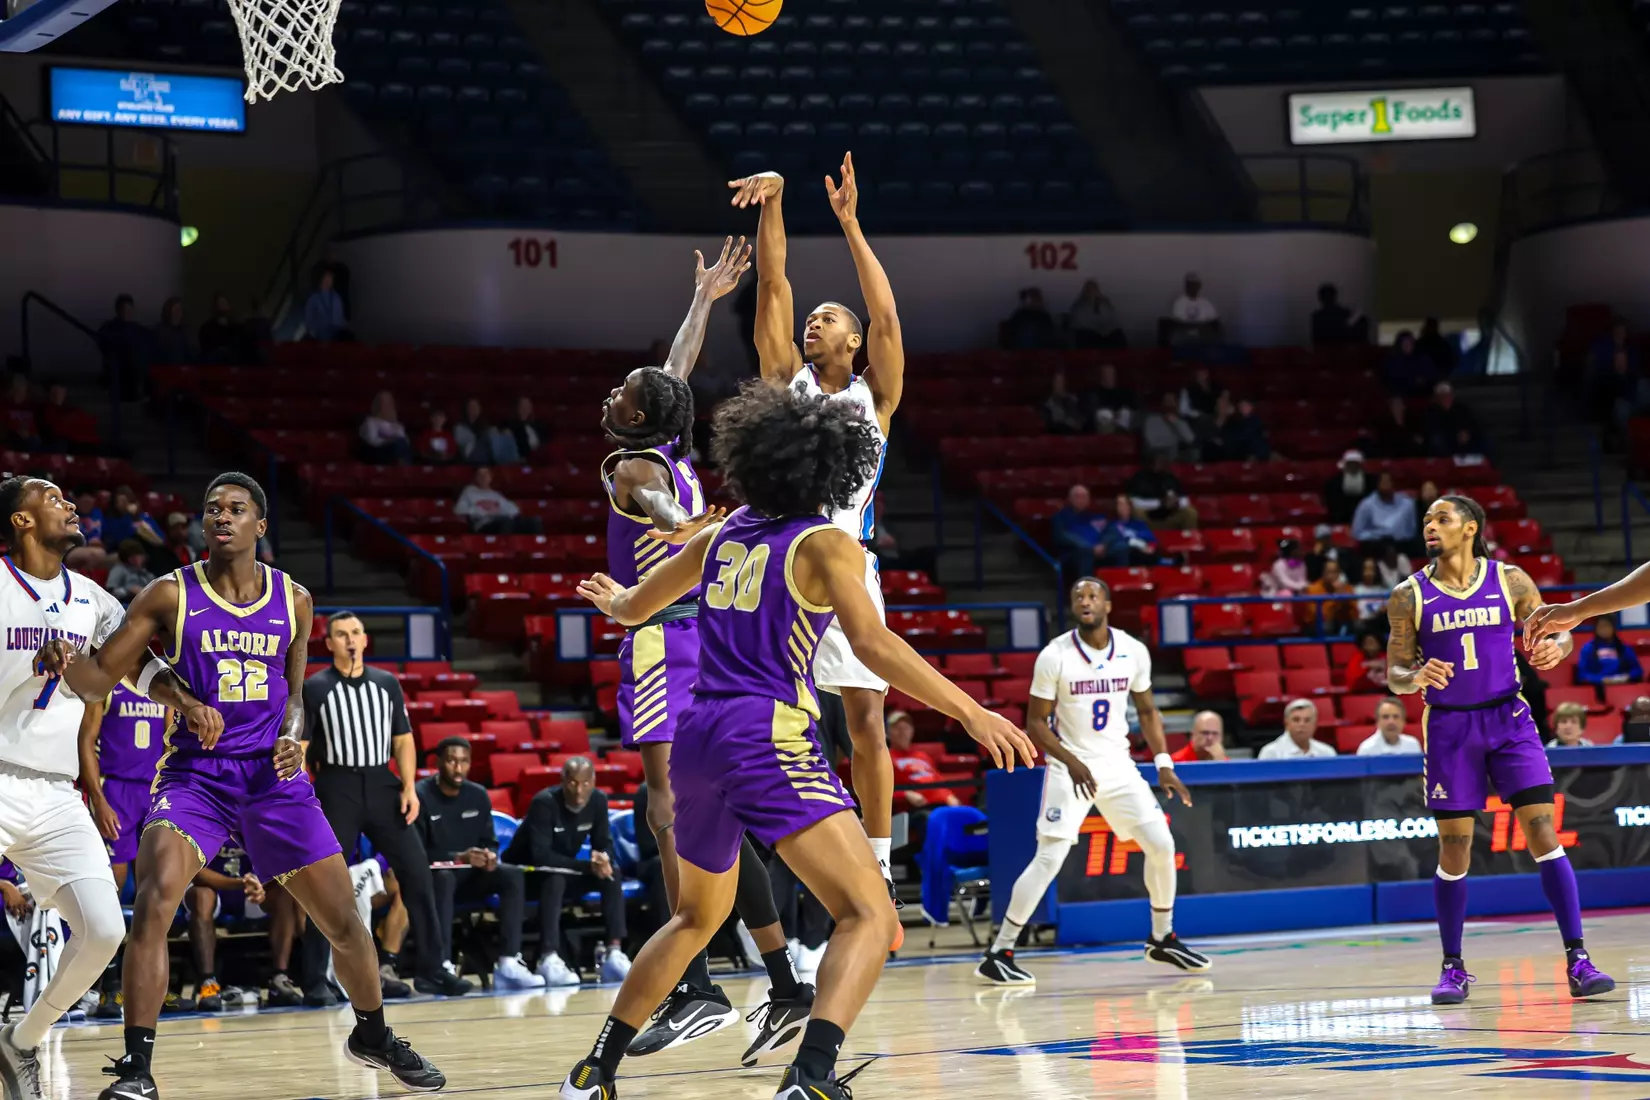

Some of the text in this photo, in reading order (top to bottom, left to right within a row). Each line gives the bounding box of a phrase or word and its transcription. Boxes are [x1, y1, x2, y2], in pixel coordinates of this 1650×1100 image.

[1299, 95, 1463, 134] Super 1 Foods
[506, 237, 558, 269] 101
[1024, 242, 1078, 270] 102
[705, 540, 771, 613] 30
[1432, 606, 1501, 633] ALCORN
[200, 629, 281, 656] ALCORN
[1460, 632, 1479, 671] 1
[216, 658, 269, 702] 22
[1069, 679, 1110, 695] LOUISIANA
[118, 701, 165, 719] ALCORN
[1092, 699, 1111, 732] 8
[134, 720, 151, 749] 0
[1614, 805, 1650, 827] TIC
